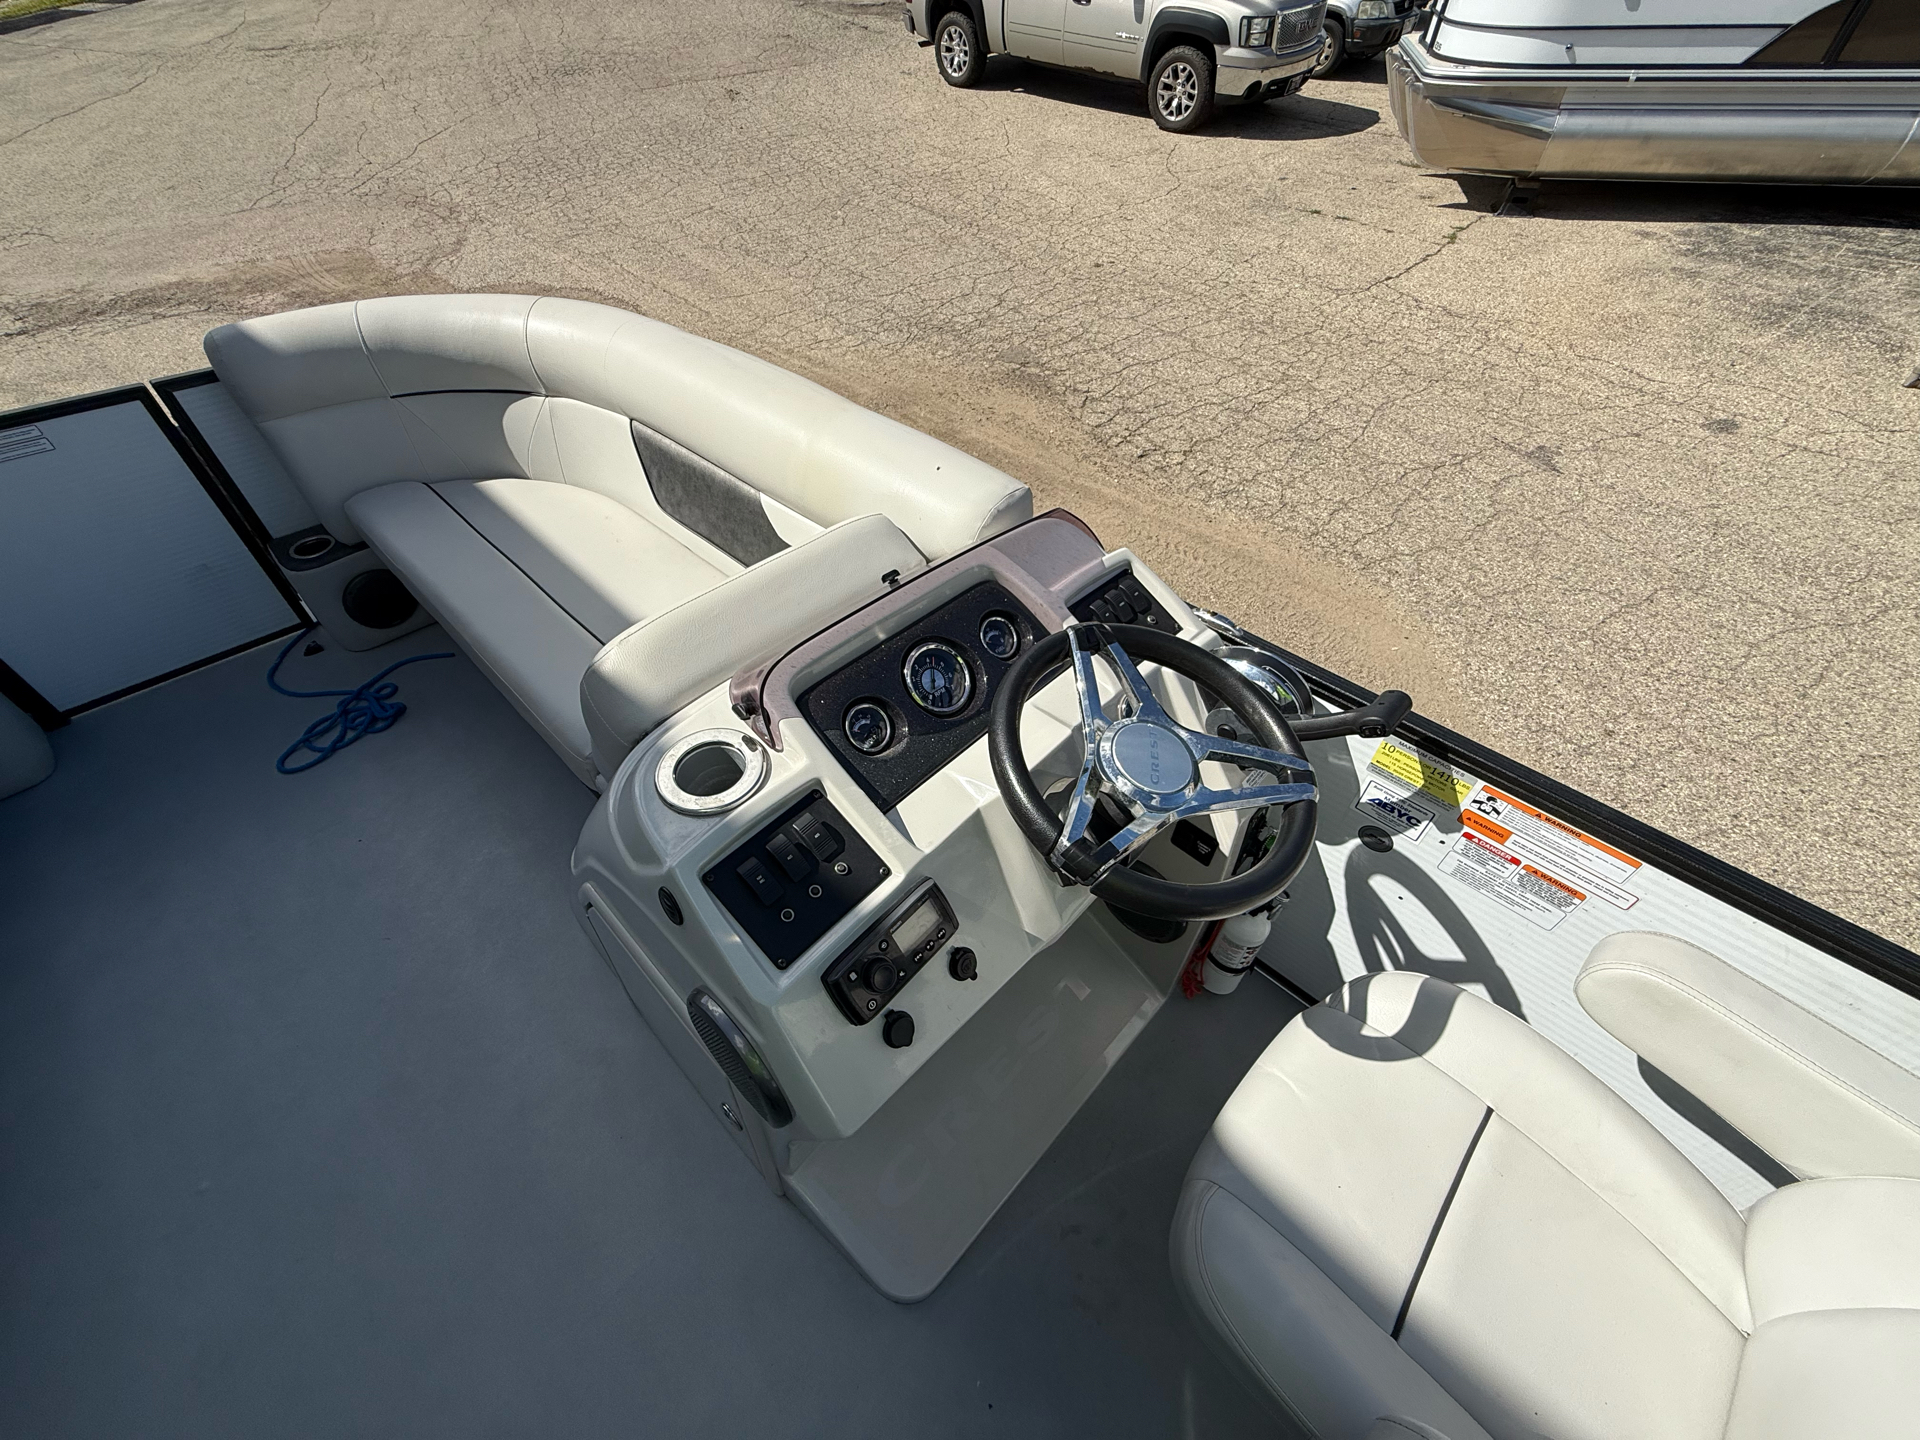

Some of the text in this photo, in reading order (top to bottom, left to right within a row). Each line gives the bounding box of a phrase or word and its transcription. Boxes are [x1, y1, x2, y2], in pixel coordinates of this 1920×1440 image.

[934, 687, 946, 698] RPM
[1150, 728, 1160, 785] CREST
[1382, 742, 1396, 754] 10
[1422, 762, 1431, 770] OR
[1429, 765, 1460, 787] 1410
[1458, 781, 1470, 790] LBS
[1398, 740, 1465, 778] MAXIMUM CAPACITIES
[1428, 781, 1445, 792] MOTOR
[1367, 798, 1421, 826] ABYC
[1384, 796, 1412, 813] Member
[1472, 818, 1504, 839] WARNING
[1543, 814, 1582, 840] WARNING
[1478, 838, 1512, 862] DANGER
[1539, 871, 1577, 896] WARNING
